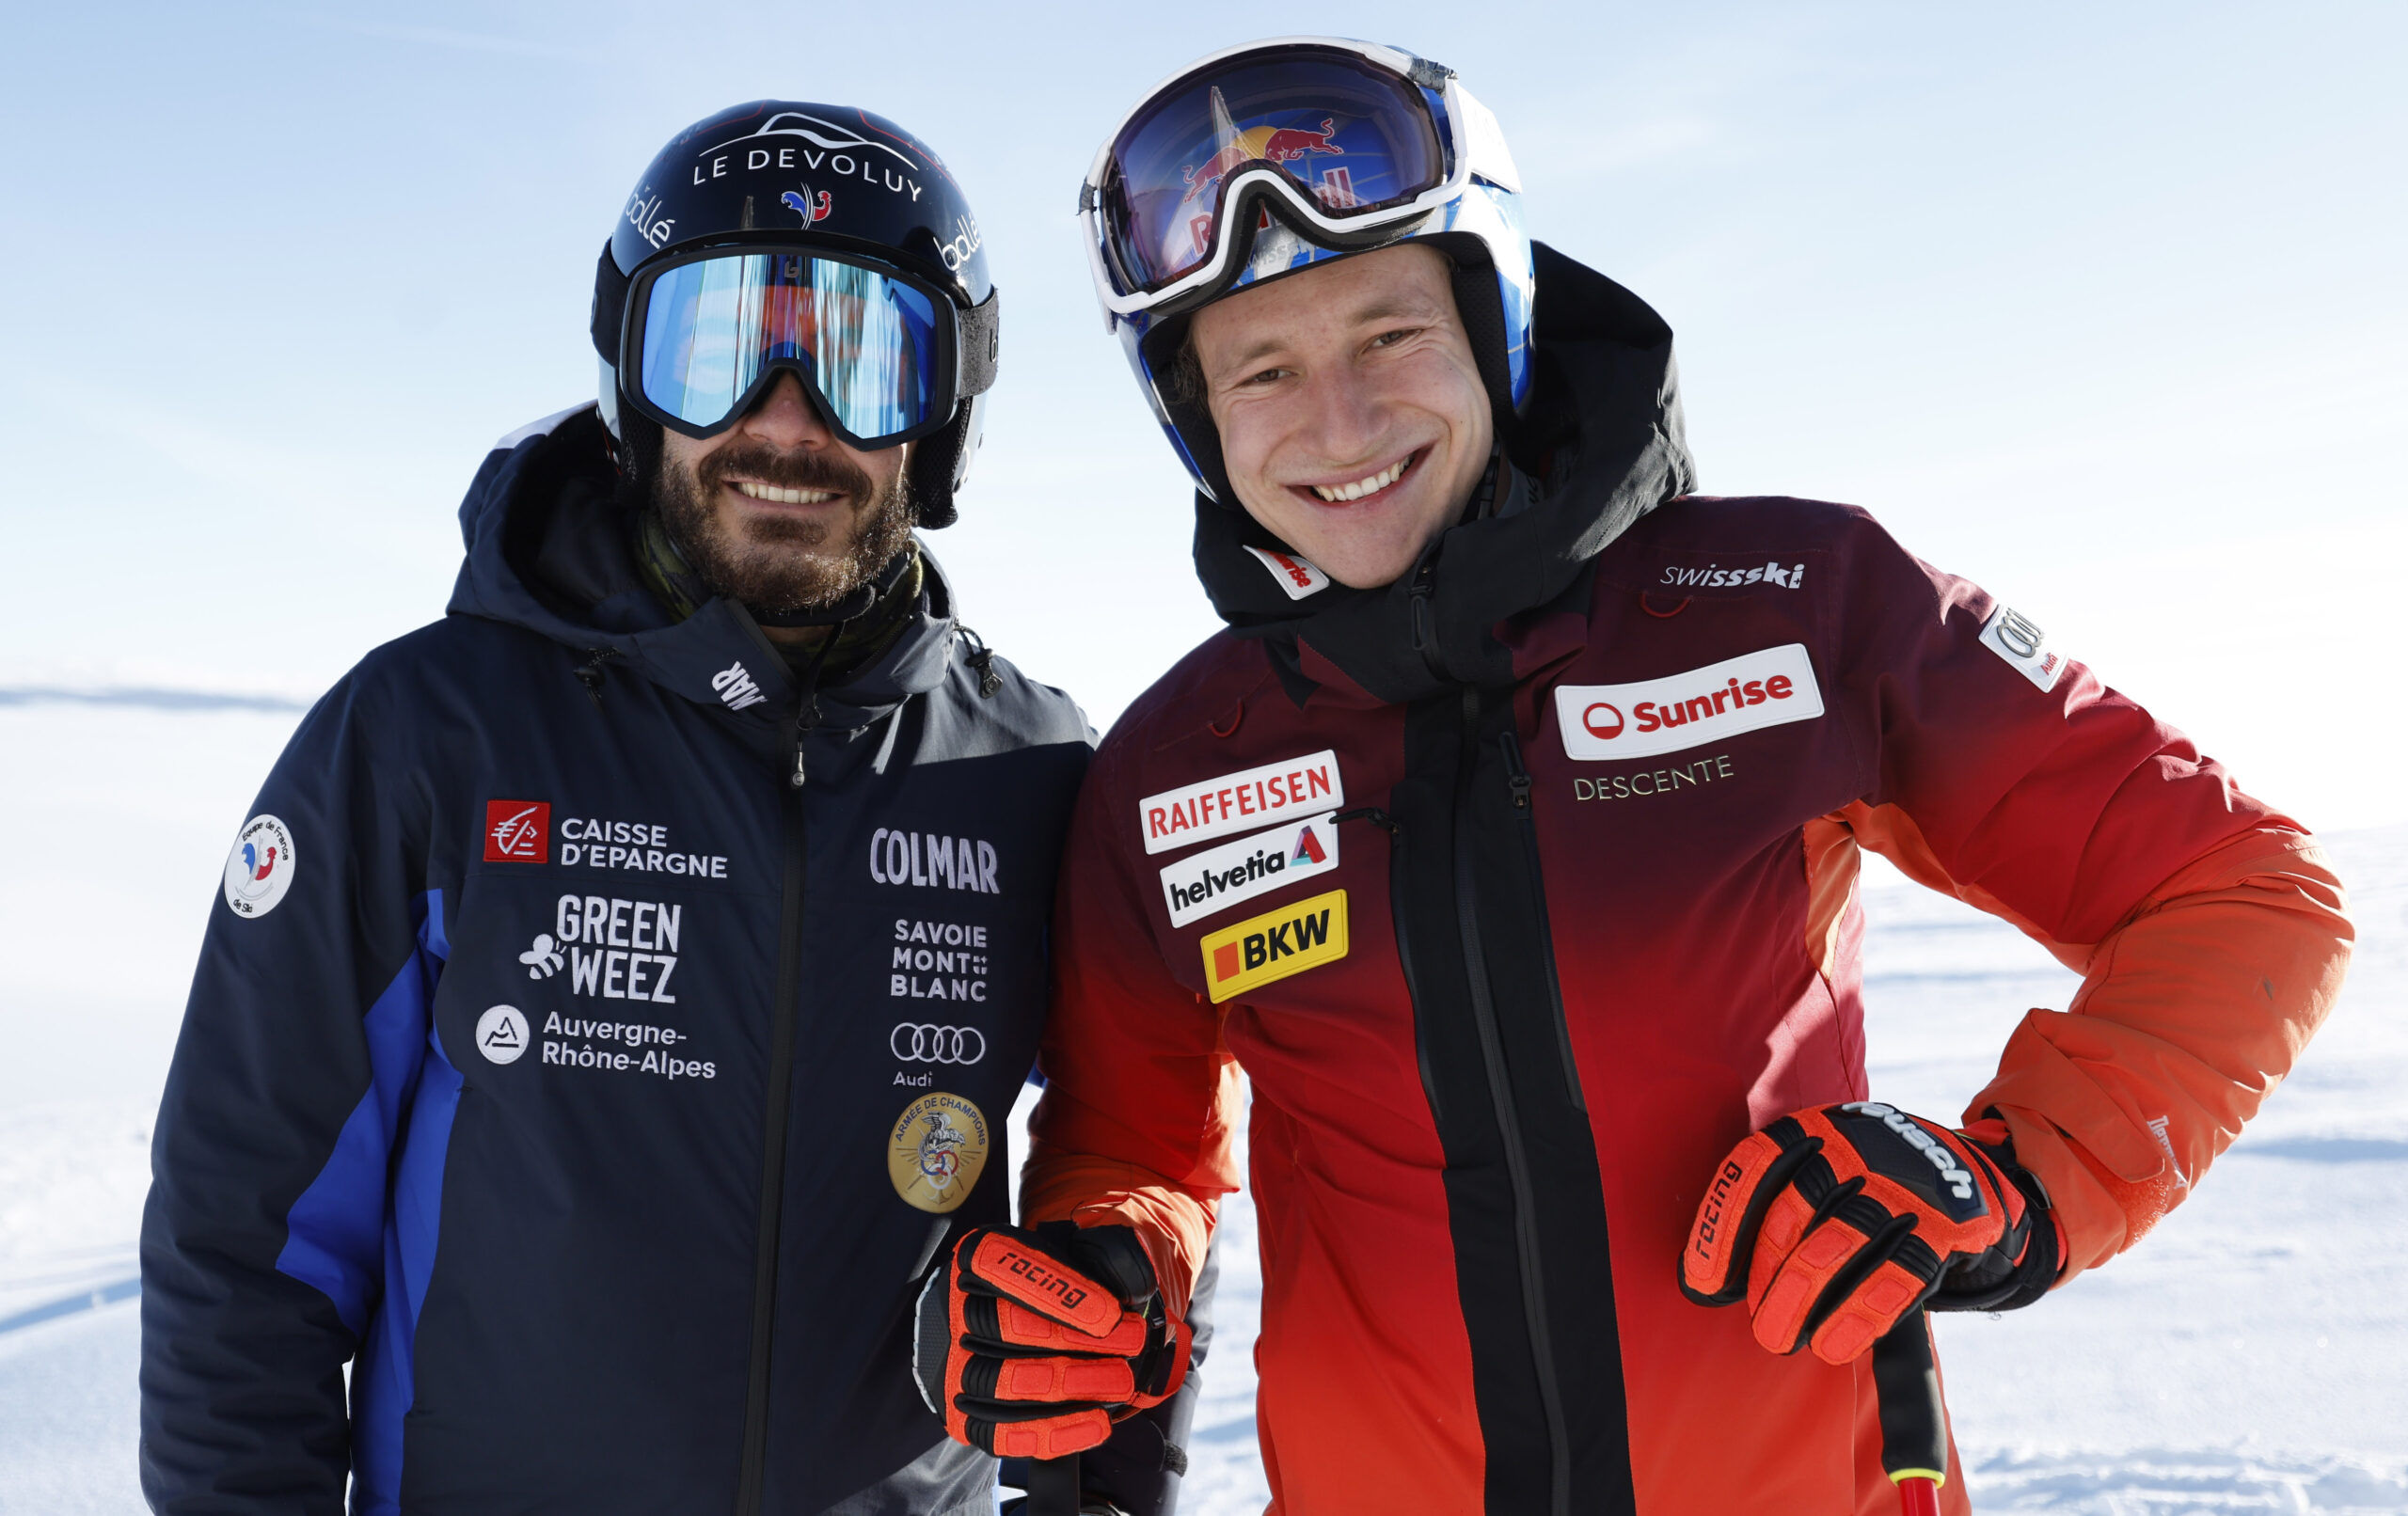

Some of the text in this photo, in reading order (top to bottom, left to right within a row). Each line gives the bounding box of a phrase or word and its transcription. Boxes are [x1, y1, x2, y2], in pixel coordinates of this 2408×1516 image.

[693, 148, 922, 203] LE DEVOLUY
[932, 213, 980, 272] bollé
[711, 661, 768, 712] MAR
[1633, 674, 1794, 733] Sunrise
[1149, 765, 1331, 839] RAIFFEISEN
[1574, 754, 1735, 801] DESCENTE
[265, 820, 275, 831] de
[274, 827, 289, 861] France
[561, 818, 668, 847] CAISSE
[561, 844, 728, 878] D'EPARGNE
[870, 828, 1000, 893] COLMAR
[1170, 849, 1286, 912] helvetia
[233, 898, 242, 909] de
[556, 893, 682, 954] GREEN
[895, 919, 988, 948] SAVOIE
[1243, 908, 1330, 971] BKW
[571, 946, 678, 1003] WEEZ
[893, 947, 974, 974] MONT
[890, 974, 988, 1003] BLANC
[543, 1011, 688, 1047] Auvergne-
[542, 1041, 717, 1081] Rhône-Alpes
[893, 1071, 932, 1087] Audi
[895, 1097, 986, 1146] ARMÉE DE CHAMPIONS
[1842, 1101, 1972, 1199] reusch
[1696, 1160, 1743, 1260] racing
[997, 1252, 1087, 1309] racing
